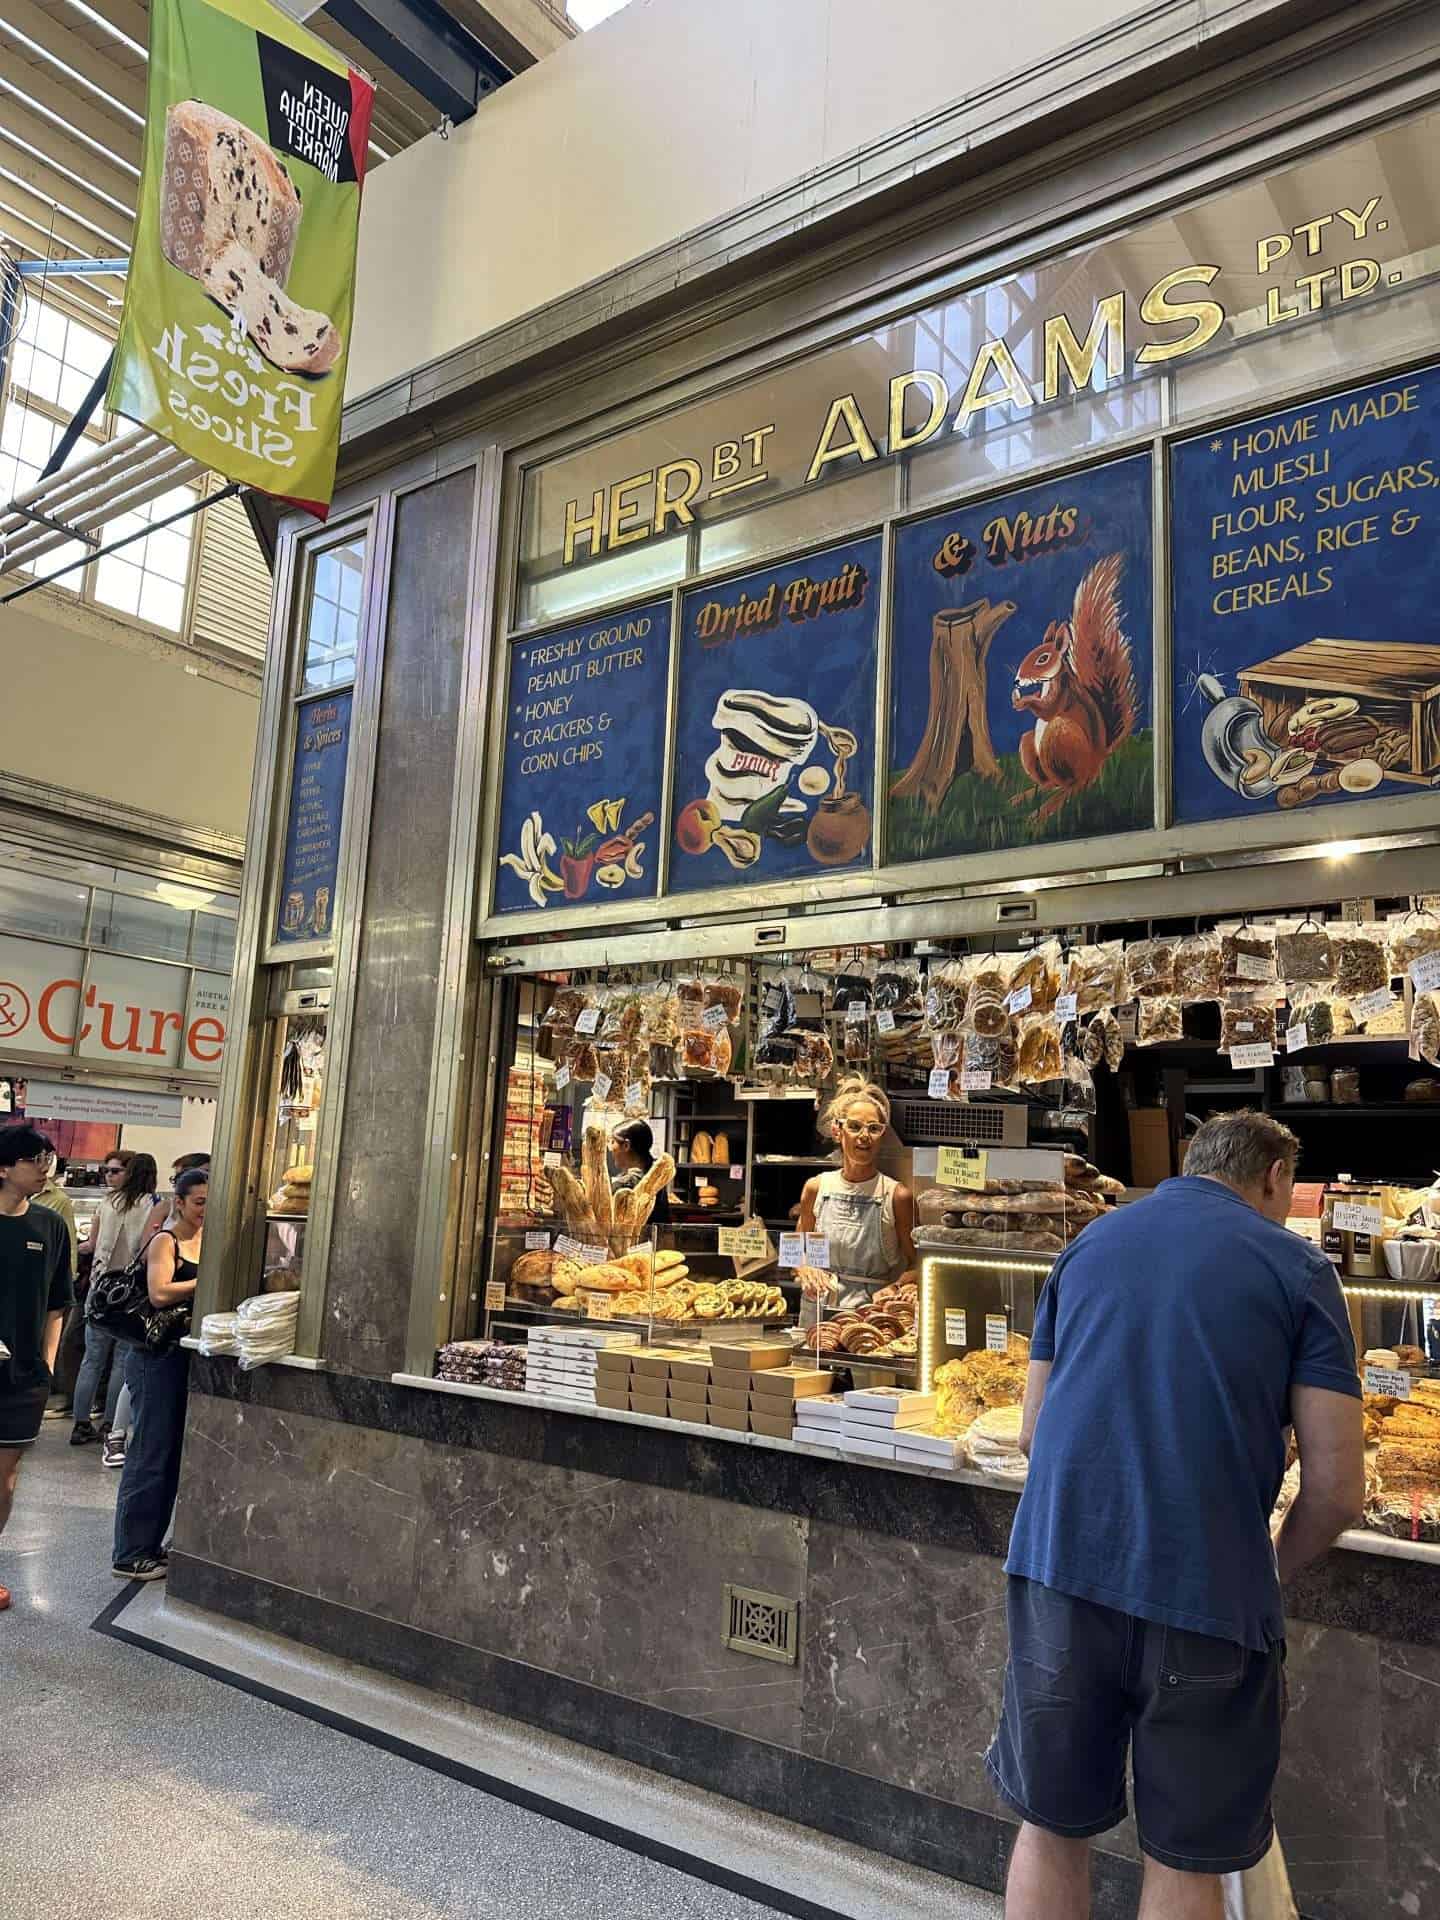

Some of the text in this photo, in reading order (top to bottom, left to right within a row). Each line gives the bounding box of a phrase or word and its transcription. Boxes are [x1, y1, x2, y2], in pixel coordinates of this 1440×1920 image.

[1256, 196, 1389, 275] PTY.
[1266, 258, 1402, 326] LTD.
[804, 264, 1226, 485] ADAMS
[1232, 384, 1420, 461] HOME MADE
[1211, 460, 1440, 540] FLOUR, SUGARS,
[1232, 449, 1330, 498] MUESLI
[933, 503, 1079, 571] & Nuts
[1212, 509, 1421, 579] BEANS, RICE &
[695, 563, 862, 640] Dried Fruit
[1212, 567, 1333, 615] CEREALS
[527, 648, 642, 694] PEANUT BUTTER
[530, 618, 651, 667] FRESHLY GROUND
[523, 712, 613, 748] CRACKERS &
[525, 694, 574, 723] HONEY
[520, 741, 604, 775] CORN CHIPS
[38, 979, 225, 1062] Cure
